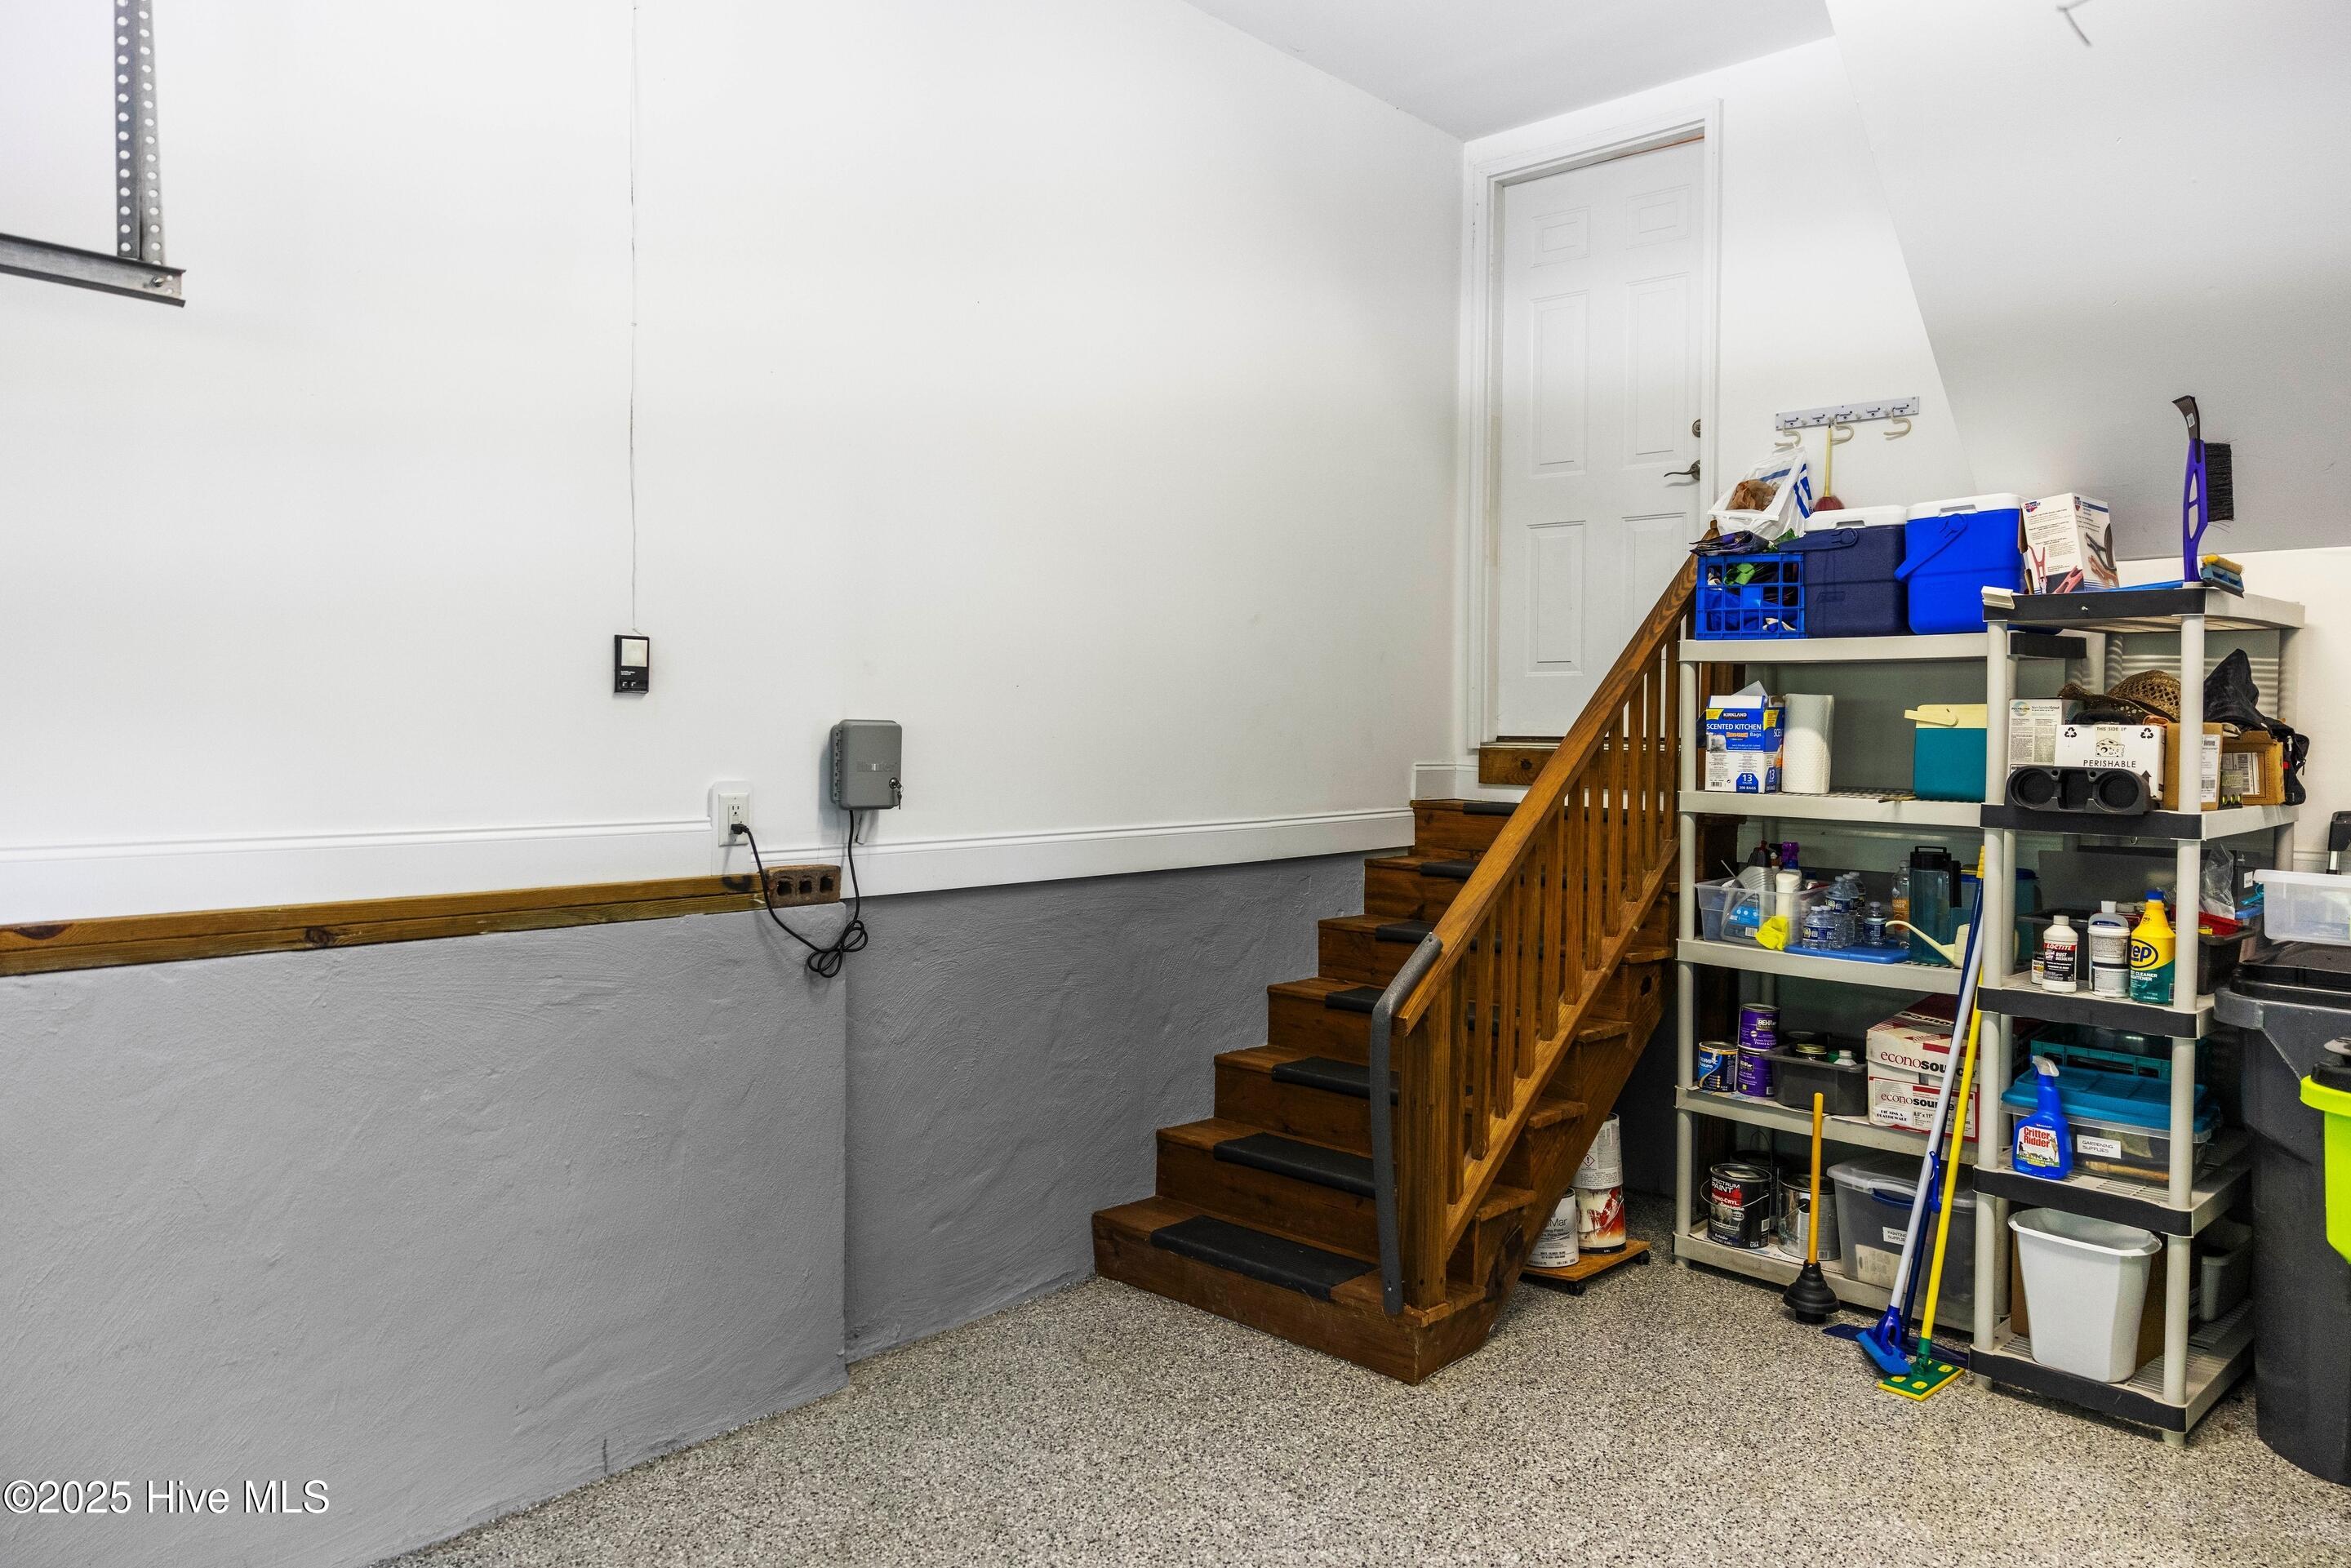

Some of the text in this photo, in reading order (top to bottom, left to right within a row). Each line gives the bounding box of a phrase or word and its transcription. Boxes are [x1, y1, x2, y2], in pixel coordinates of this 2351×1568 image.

[2083, 759, 2136, 768] PERISHABLE
[1742, 774, 1753, 782] 13
[2046, 943, 2073, 951] LOCTITE
[2024, 1126, 2051, 1140] Critter
[2024, 1135, 2051, 1148] Ridder
[2082, 1139, 2114, 1149] GARDENING
[1711, 1181, 1734, 1193] PAINT
